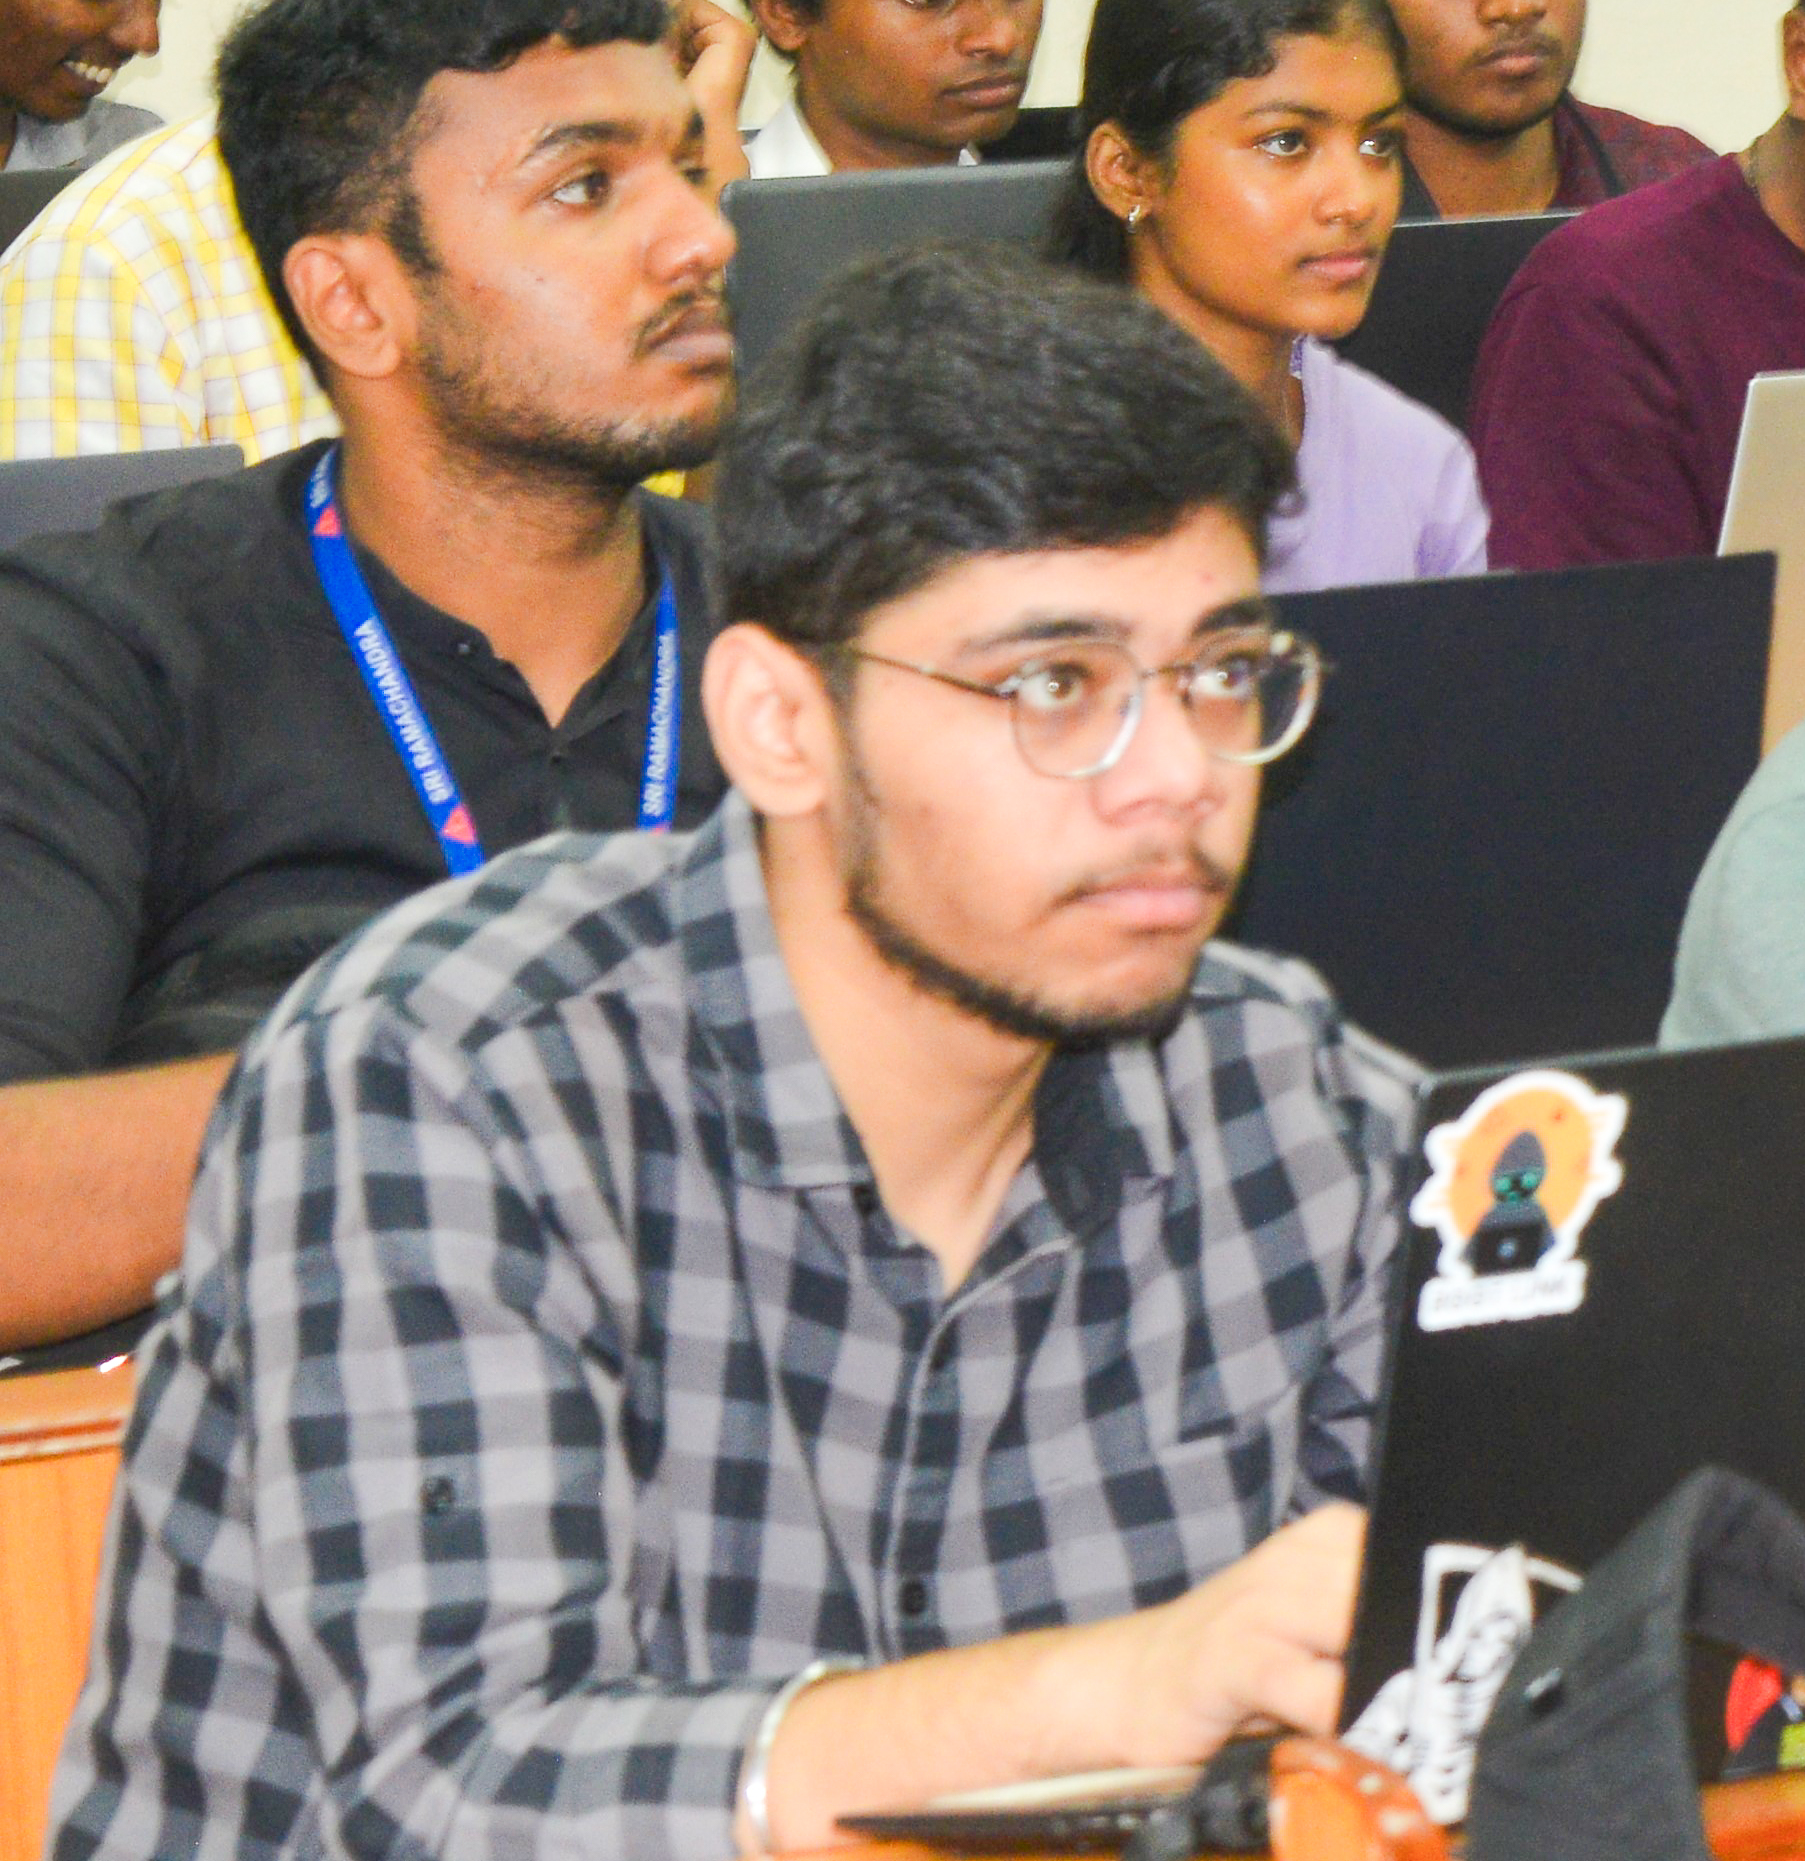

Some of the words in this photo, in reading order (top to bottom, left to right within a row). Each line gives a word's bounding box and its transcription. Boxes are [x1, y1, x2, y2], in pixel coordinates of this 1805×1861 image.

[353, 616, 435, 770] RAMACHANDRA
[646, 627, 677, 781] RAMACHANDRA
[420, 767, 455, 805] SRI
[642, 780, 665, 816] SRI
